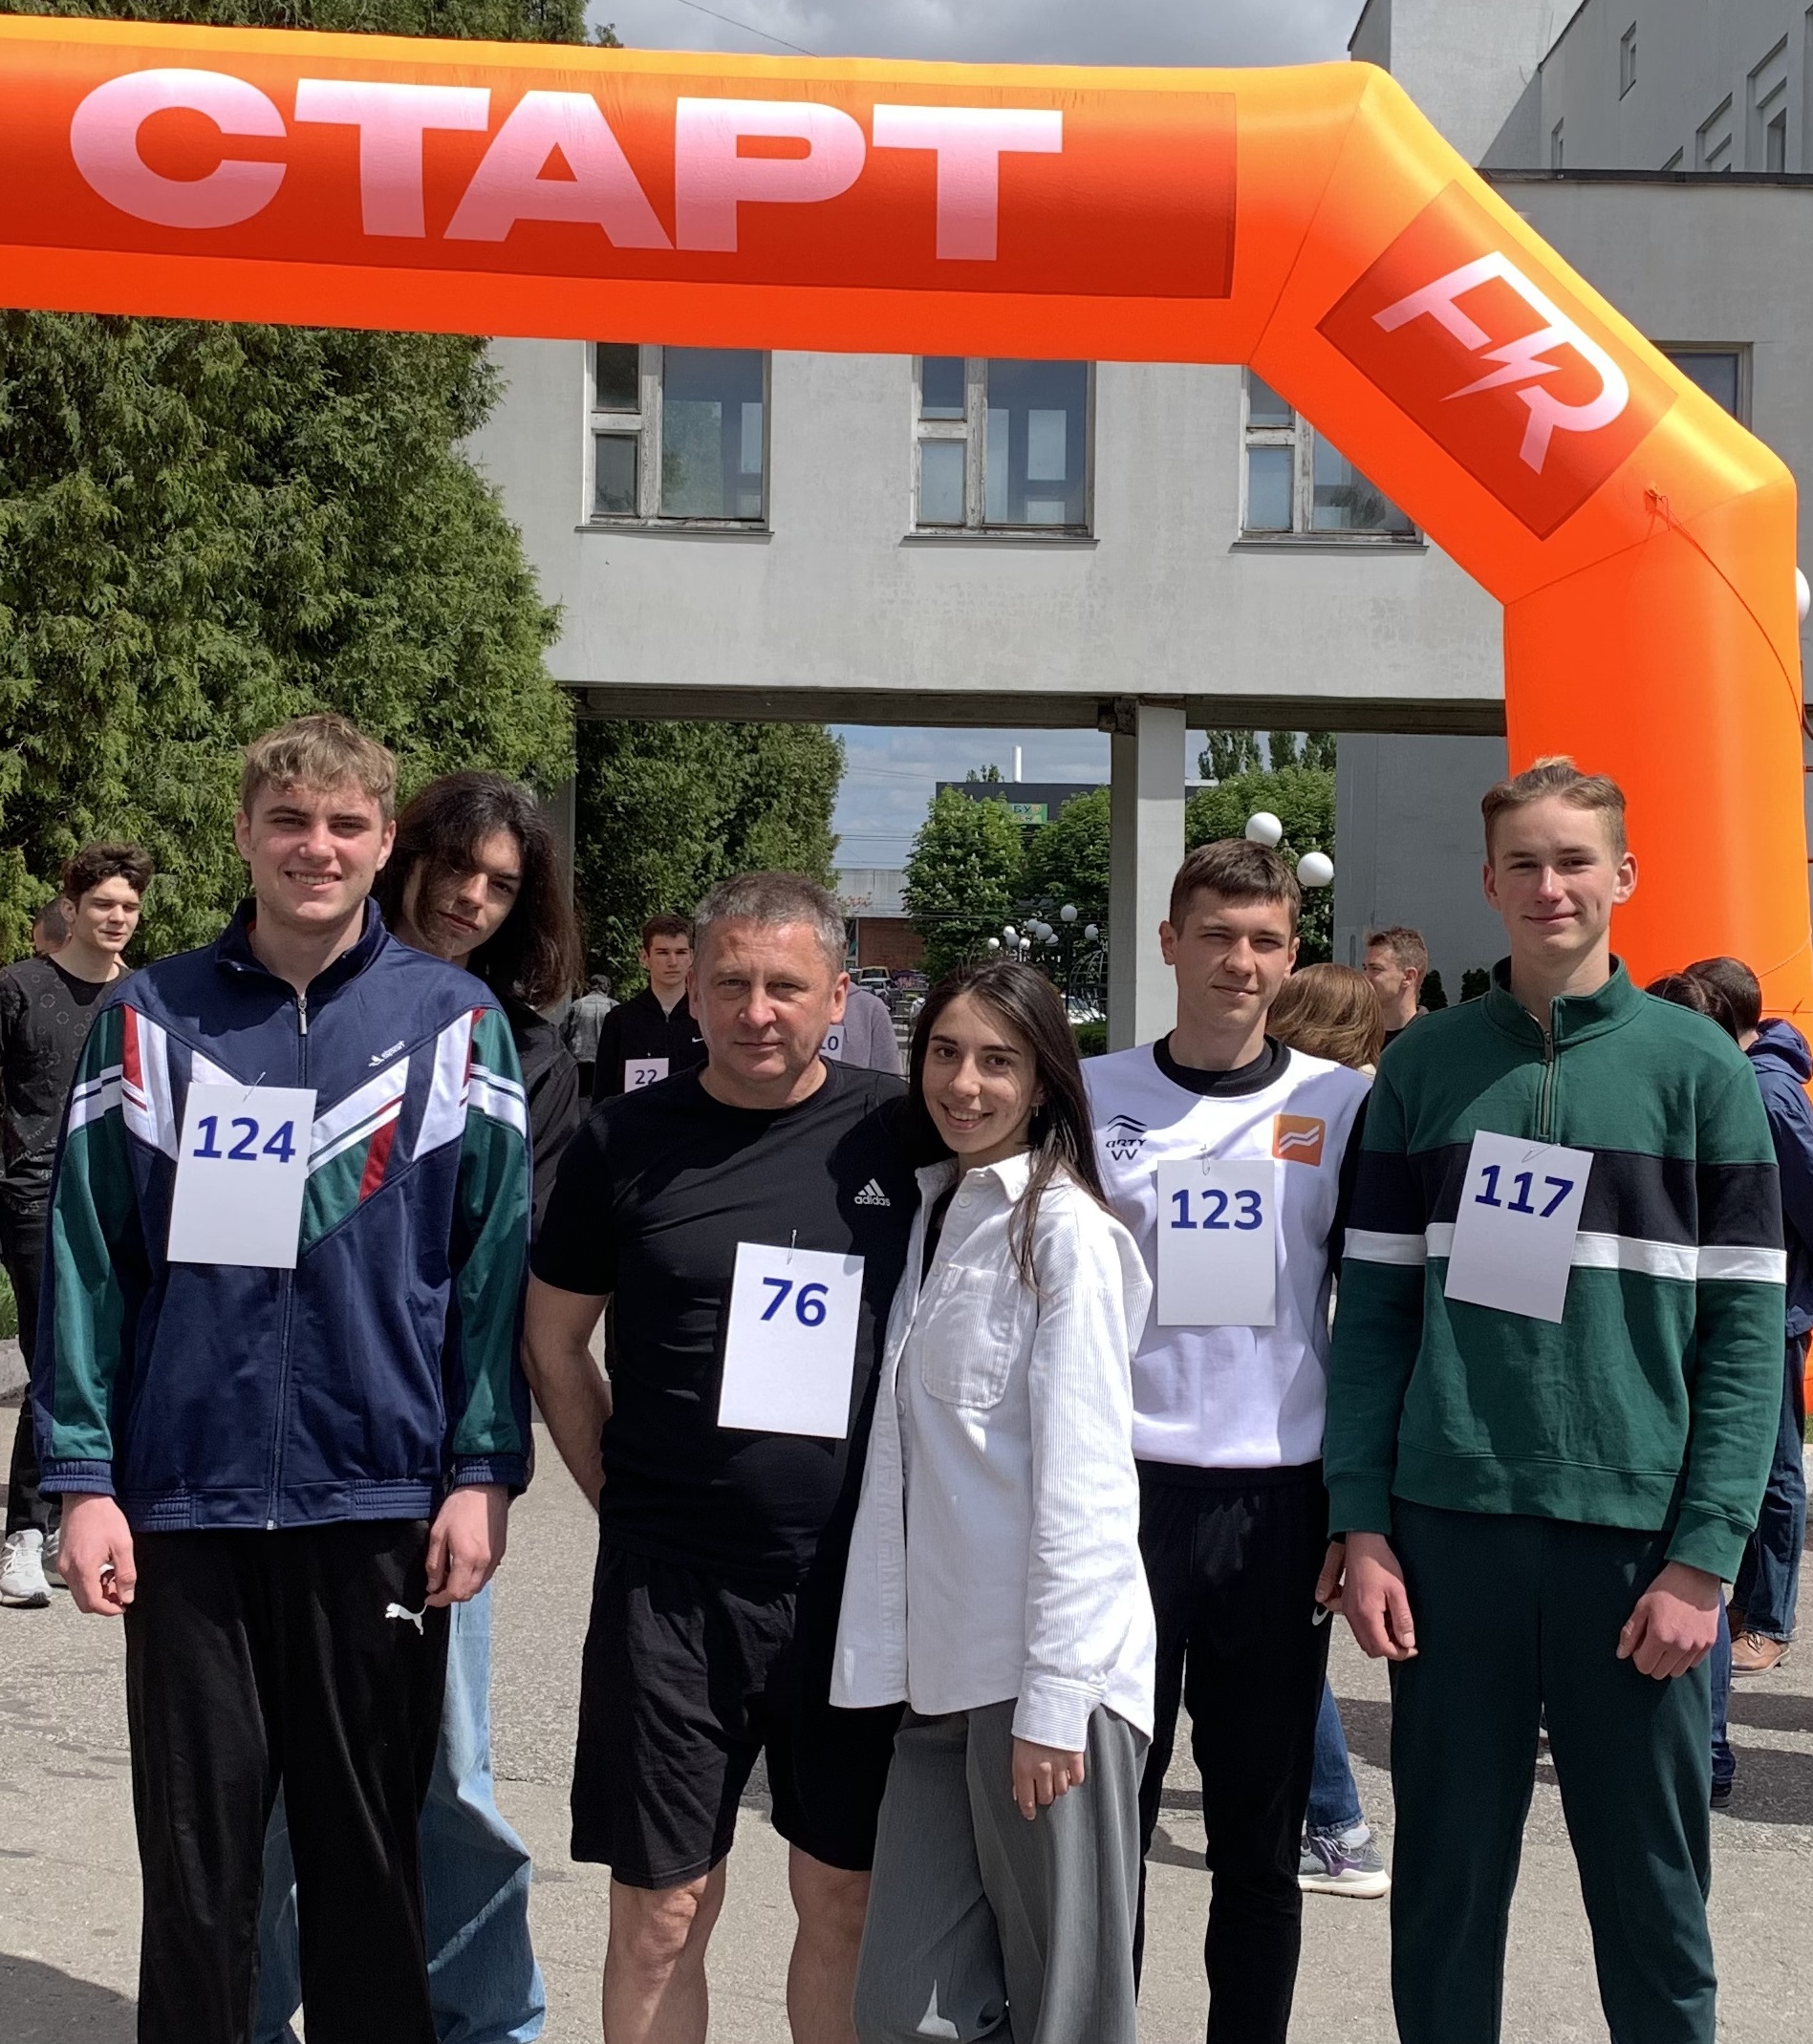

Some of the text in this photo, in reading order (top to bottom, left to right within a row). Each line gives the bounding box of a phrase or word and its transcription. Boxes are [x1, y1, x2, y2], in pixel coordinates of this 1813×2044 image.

[70, 66, 1064, 263] СТАРТ
[635, 1068, 658, 1085] 22
[193, 1115, 296, 1164] 124
[853, 1194, 891, 1206] adidas
[1171, 1189, 1263, 1231] 123
[1475, 1164, 1575, 1218] 117
[760, 1277, 830, 1327] 76
